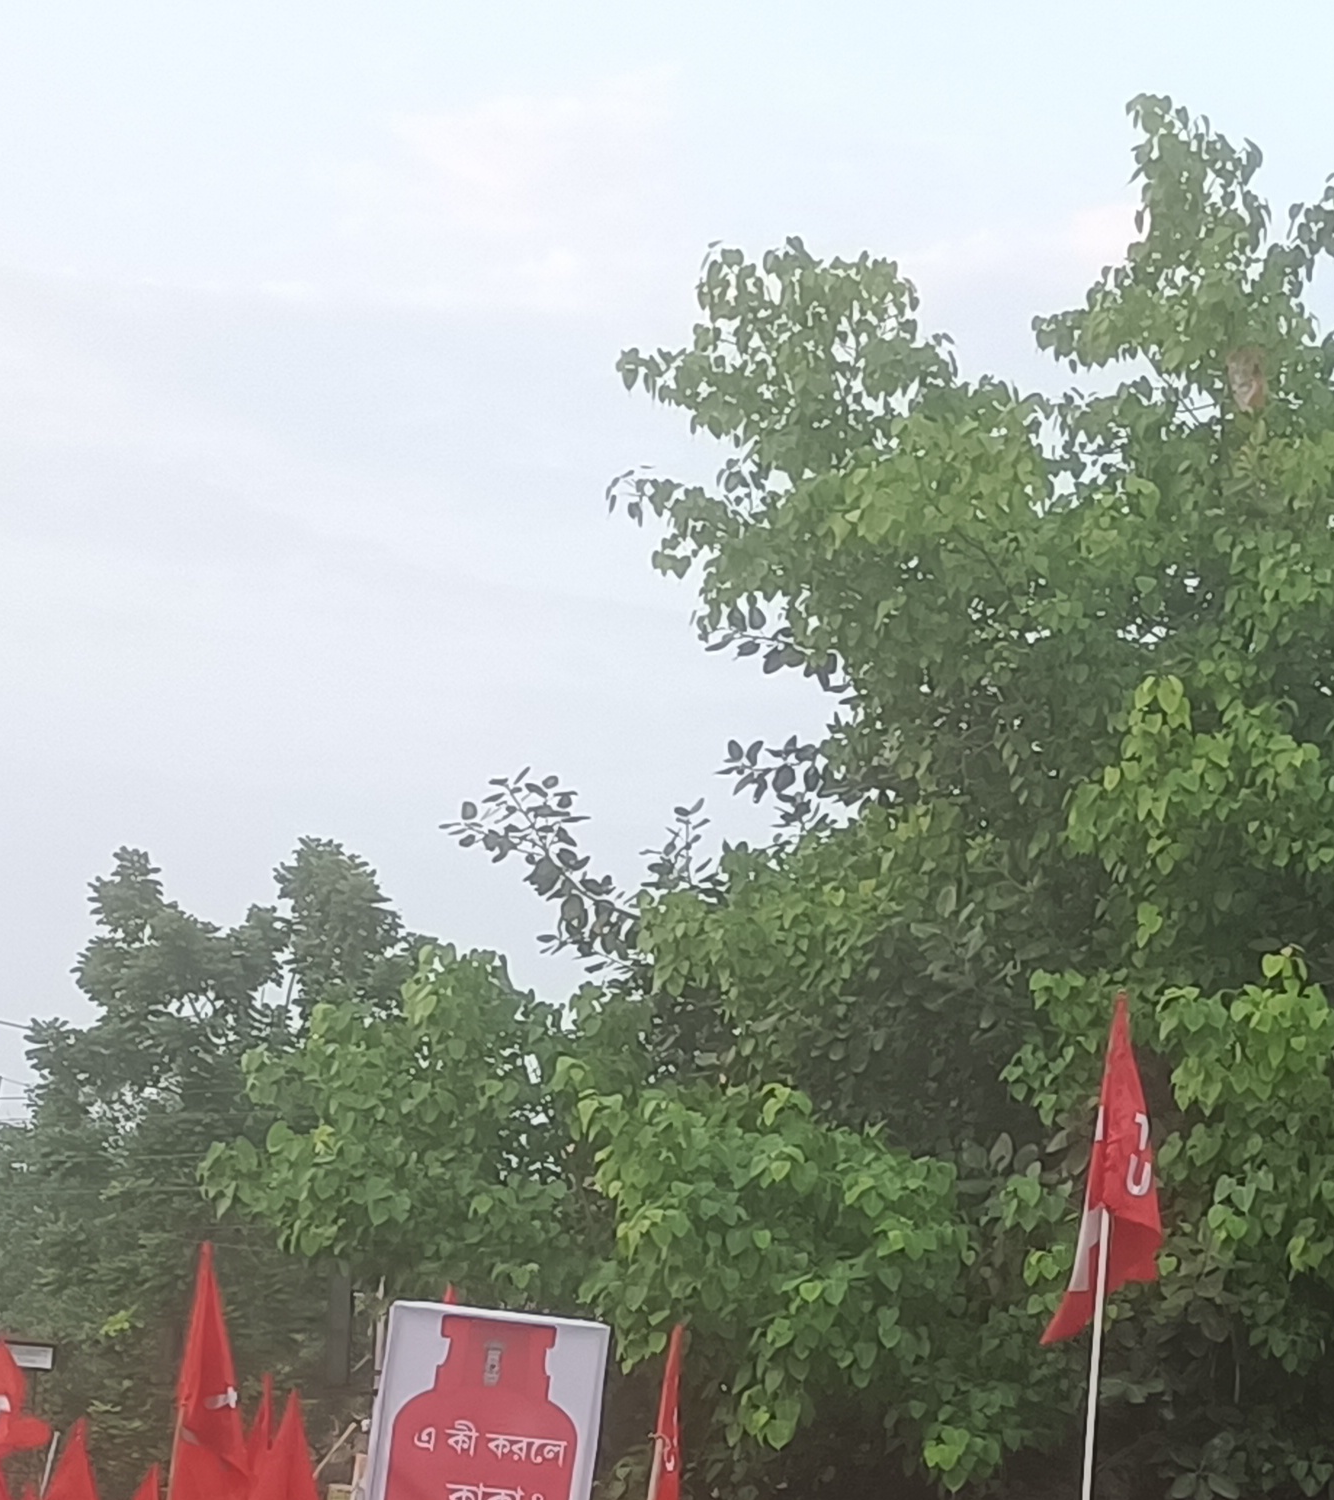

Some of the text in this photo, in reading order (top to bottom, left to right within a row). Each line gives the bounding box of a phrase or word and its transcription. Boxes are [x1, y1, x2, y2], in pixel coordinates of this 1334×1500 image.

[414, 1420, 568, 1467] এ কী করলে
